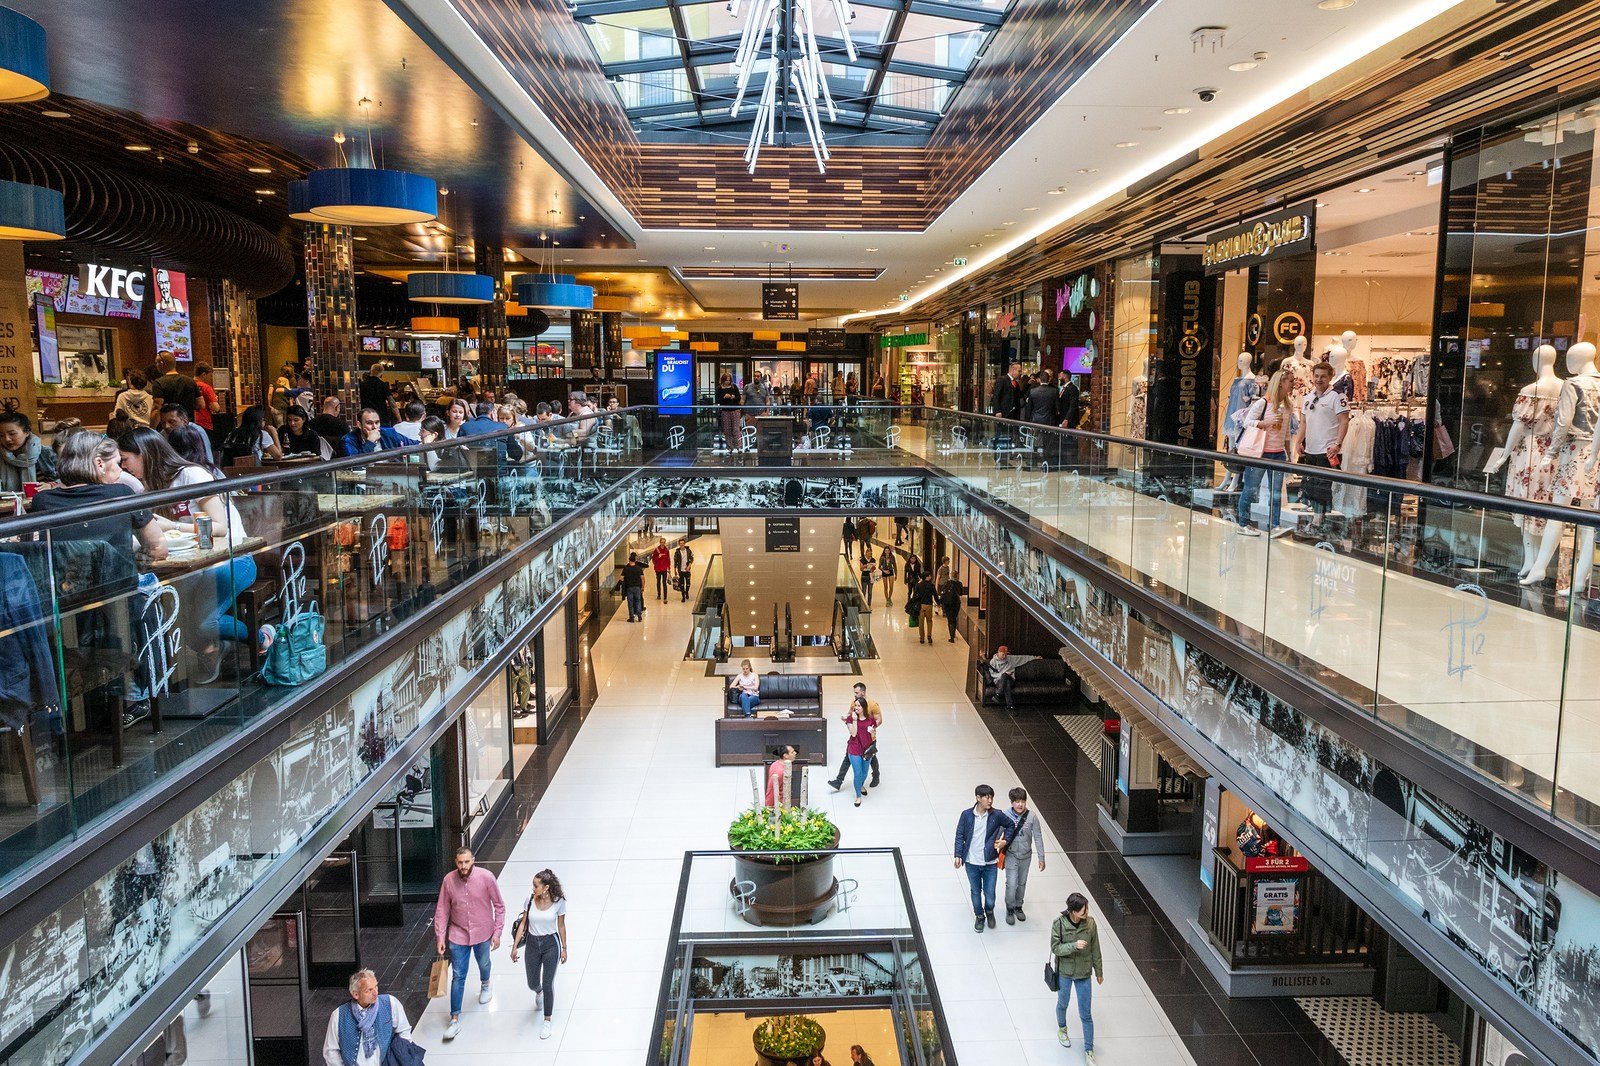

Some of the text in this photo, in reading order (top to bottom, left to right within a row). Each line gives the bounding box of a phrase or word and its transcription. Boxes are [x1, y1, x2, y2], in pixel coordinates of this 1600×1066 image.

[1202, 230, 1253, 266] FASHION
[1263, 214, 1308, 250] CLUB
[86, 263, 143, 302] KFC
[1182, 279, 1201, 336] CLUB
[662, 364, 675, 373] DU
[1177, 359, 1197, 447] FASHION
[1271, 857, 1284, 865] FÜR
[1272, 976, 1334, 987] HOLLISTER Co.
